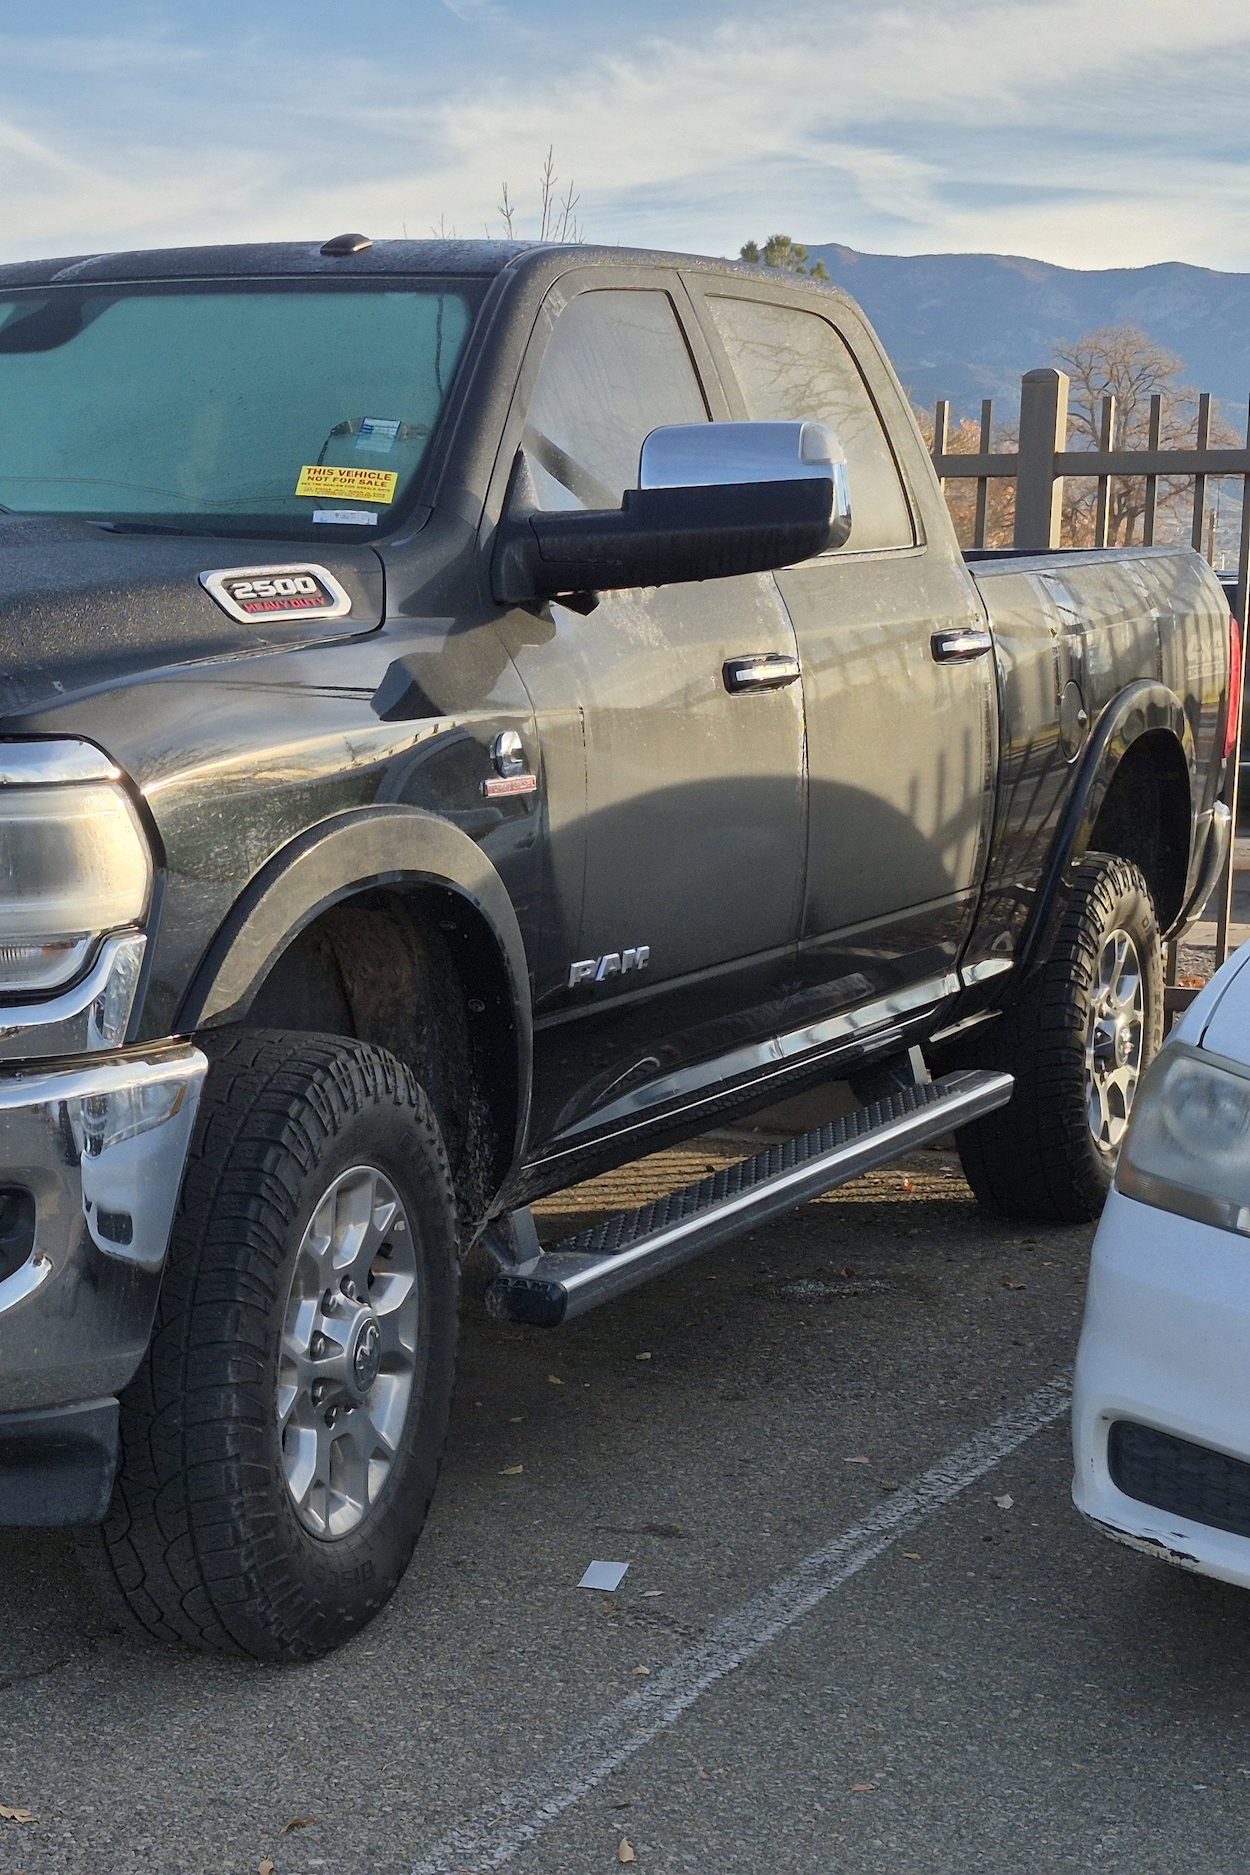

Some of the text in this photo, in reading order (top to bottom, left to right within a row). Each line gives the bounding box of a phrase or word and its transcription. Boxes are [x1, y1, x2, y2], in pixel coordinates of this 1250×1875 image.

[307, 467, 393, 481] THIS VEHICLE
[332, 476, 355, 484] FOR
[359, 479, 389, 488] SALE
[230, 576, 318, 600] 2500
[244, 597, 326, 613] HEAVY DUTY
[568, 945, 650, 988] RAM
